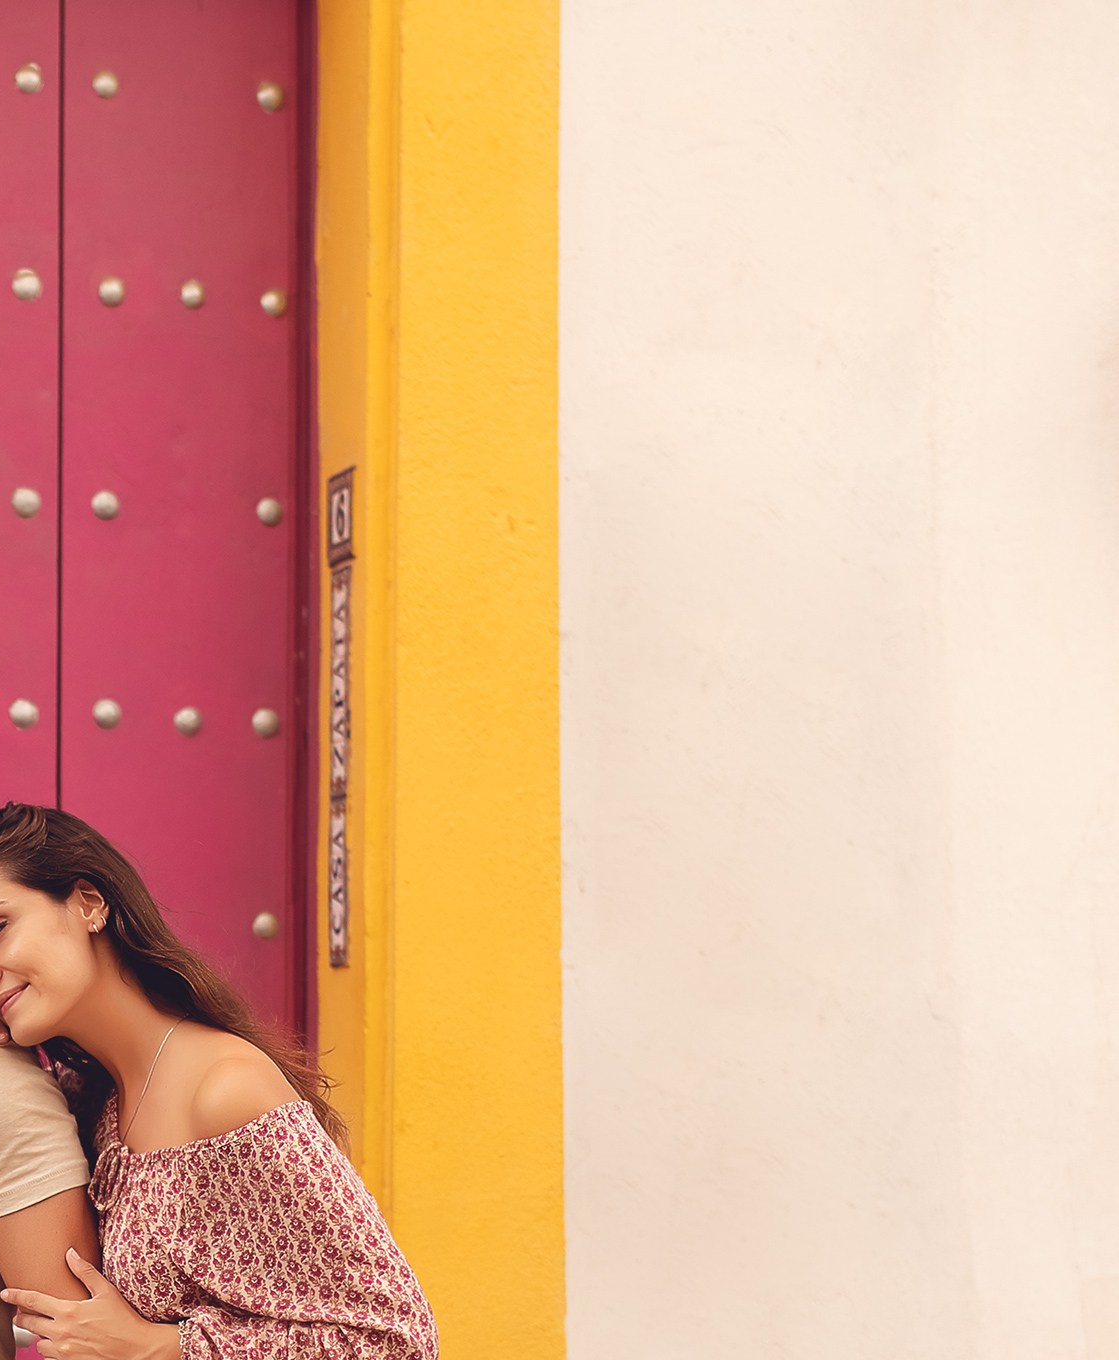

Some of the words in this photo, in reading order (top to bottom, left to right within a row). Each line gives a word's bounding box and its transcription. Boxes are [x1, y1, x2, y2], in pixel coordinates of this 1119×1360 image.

[335, 491, 346, 538] 6
[333, 602, 347, 767] ZAPATA
[332, 830, 345, 935] CASA
